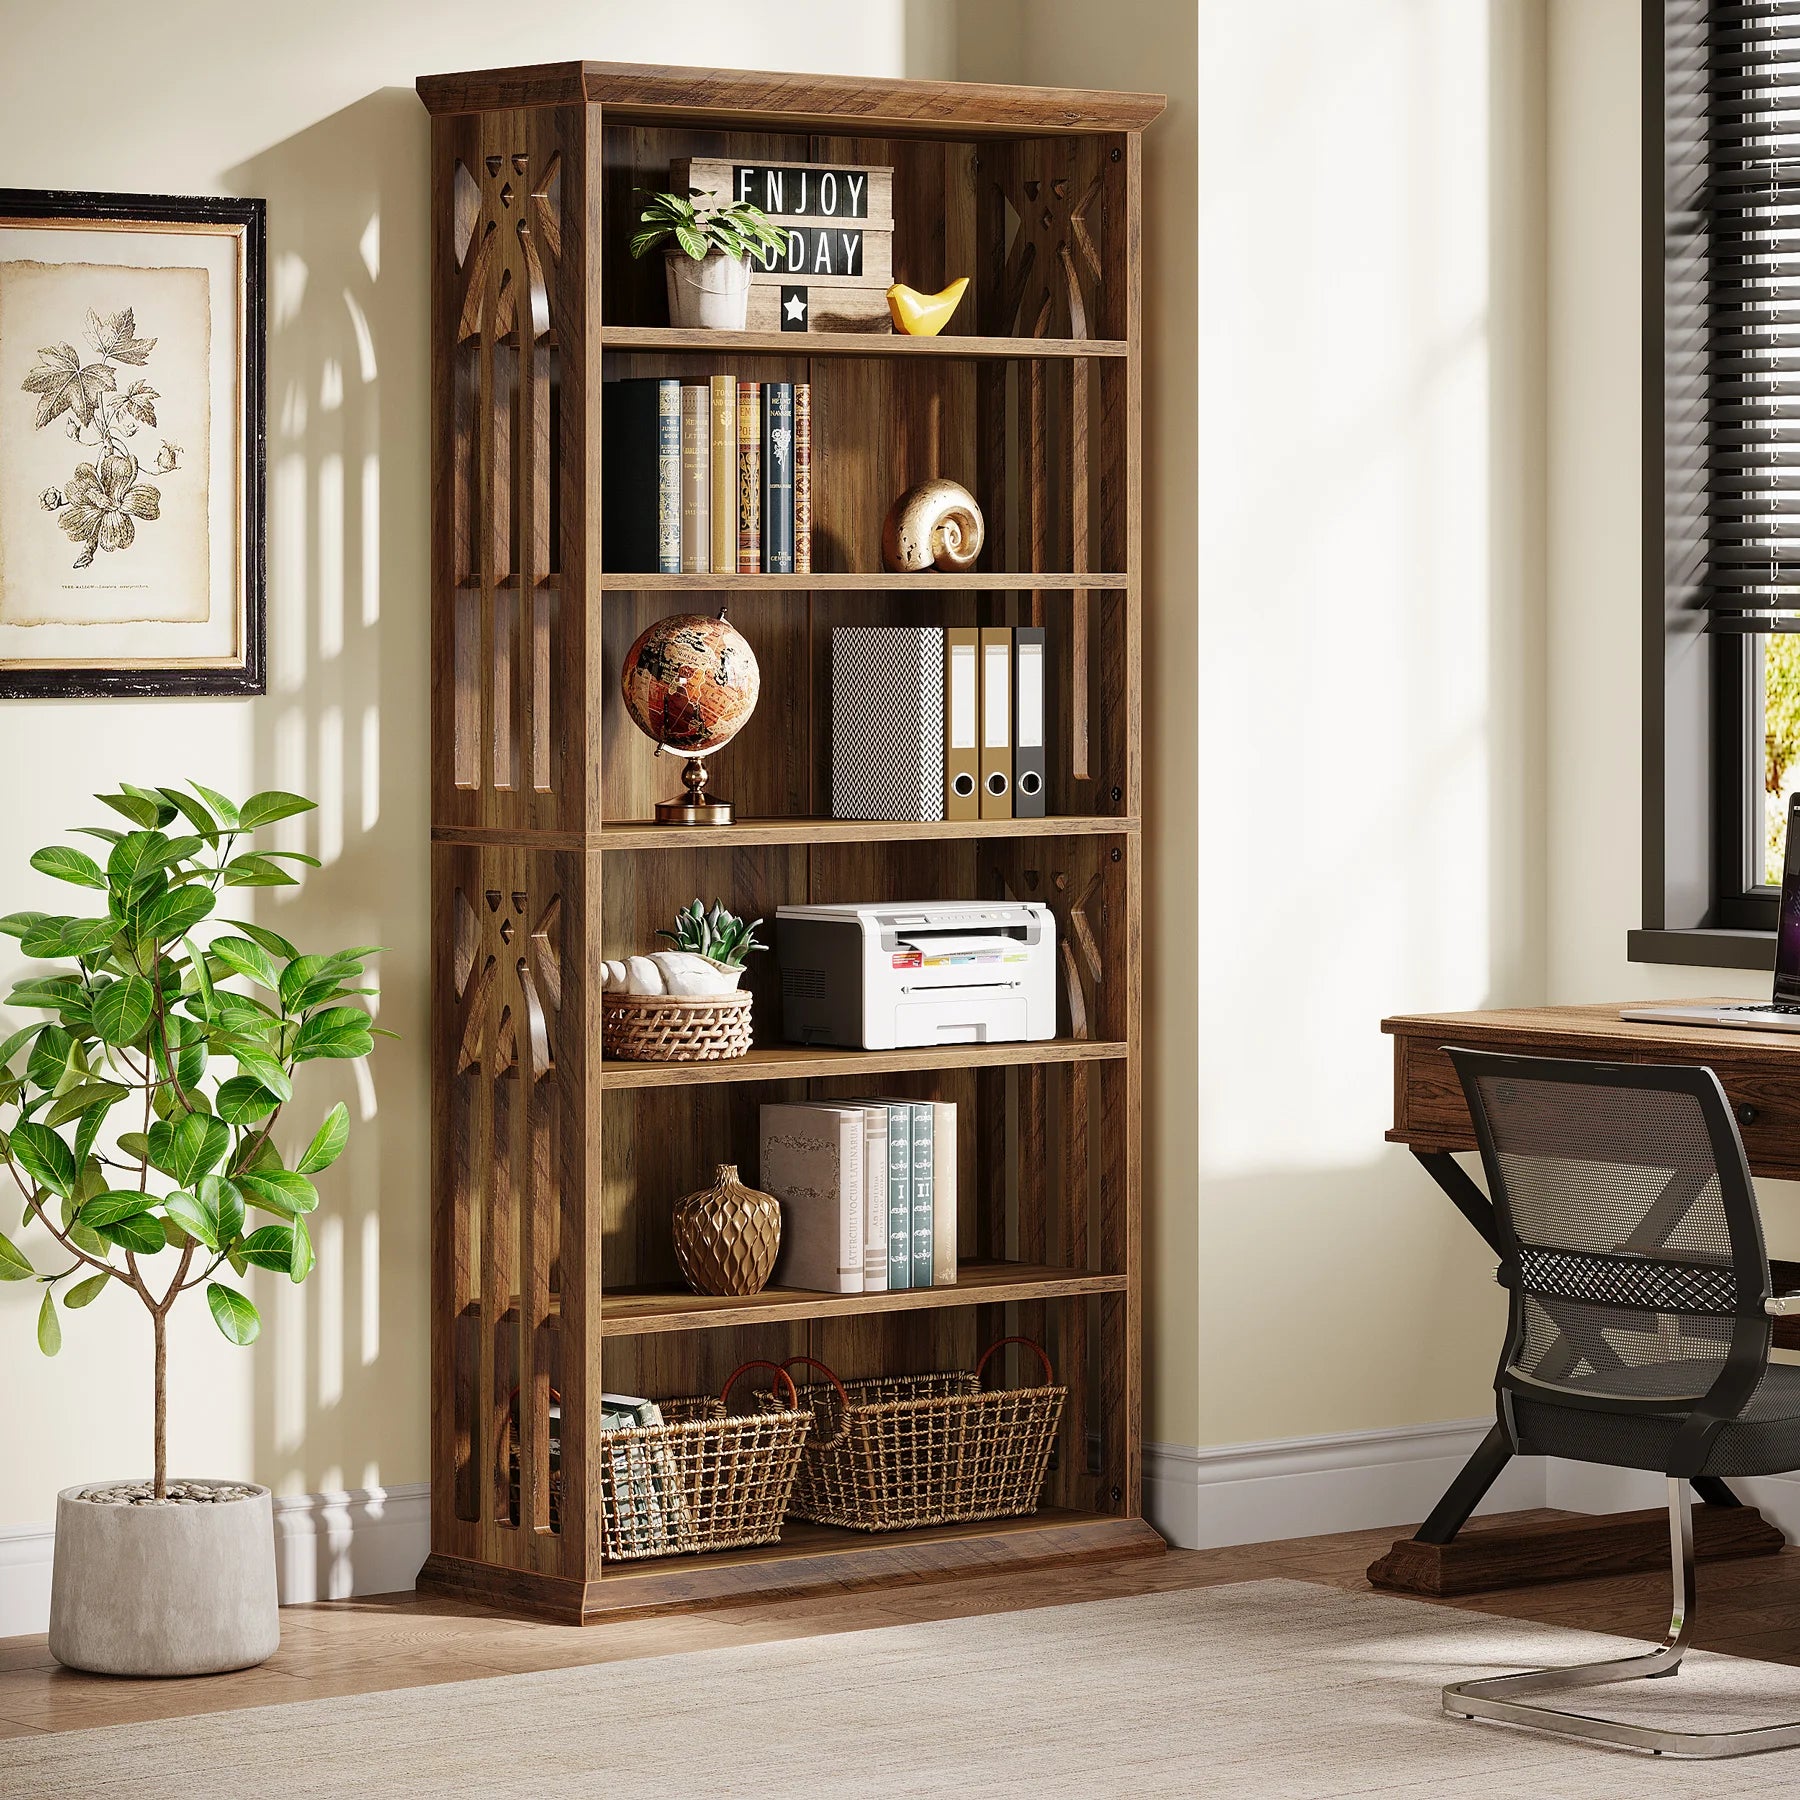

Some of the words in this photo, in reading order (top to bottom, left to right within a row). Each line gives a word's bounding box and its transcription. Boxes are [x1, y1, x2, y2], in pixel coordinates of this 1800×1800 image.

[740, 169, 864, 217] ENJOY
[849, 1124, 858, 1177] LATINARUM
[849, 1180, 858, 1215] VOCUM
[898, 1185, 904, 1199] I
[917, 1183, 930, 1197] II
